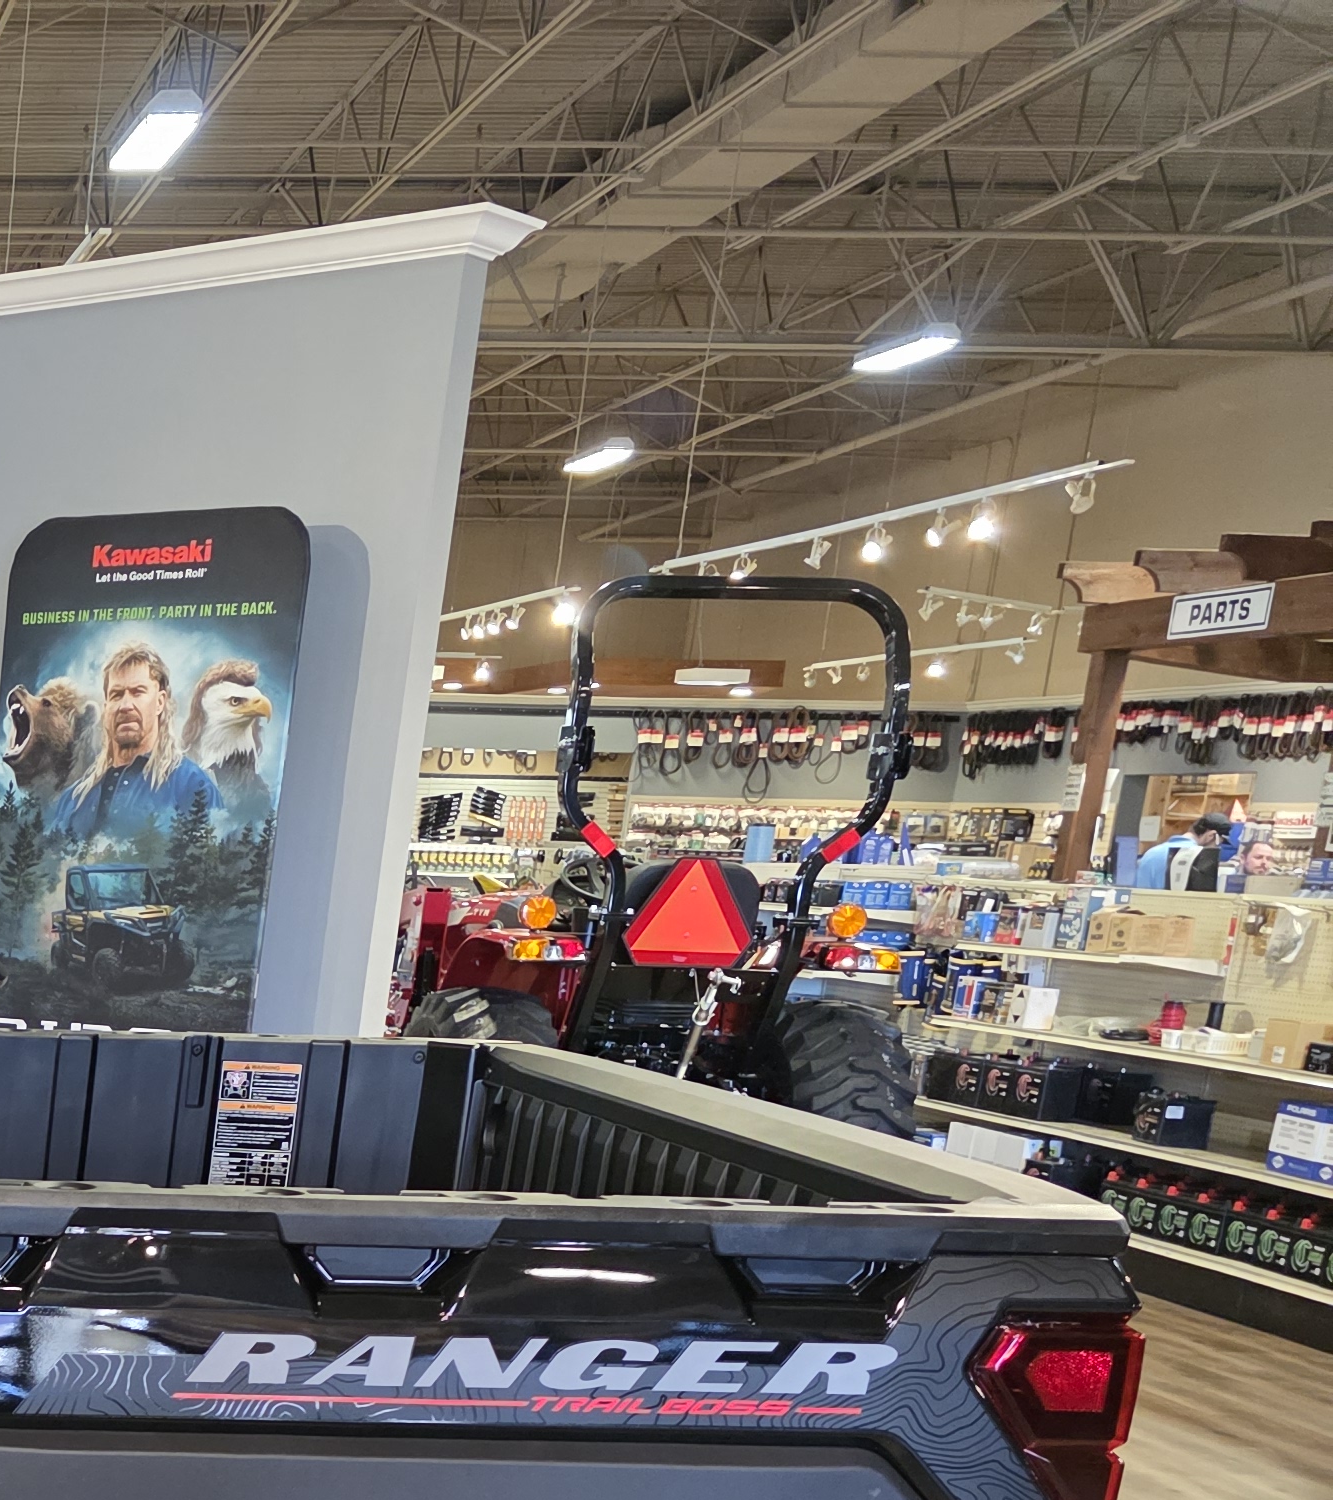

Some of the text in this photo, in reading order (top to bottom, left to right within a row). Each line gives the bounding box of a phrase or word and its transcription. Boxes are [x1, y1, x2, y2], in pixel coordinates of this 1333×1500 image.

[92, 538, 213, 567] Kawasaki
[96, 568, 204, 582] Let the Good Times Roll
[22, 601, 277, 625] BUSINESS IN THE FRONT. PARTY IN THE BACK.
[1188, 598, 1251, 626] PARTS
[184, 1331, 899, 1396] RANGER
[529, 1396, 794, 1417] TRAIL BOSS
